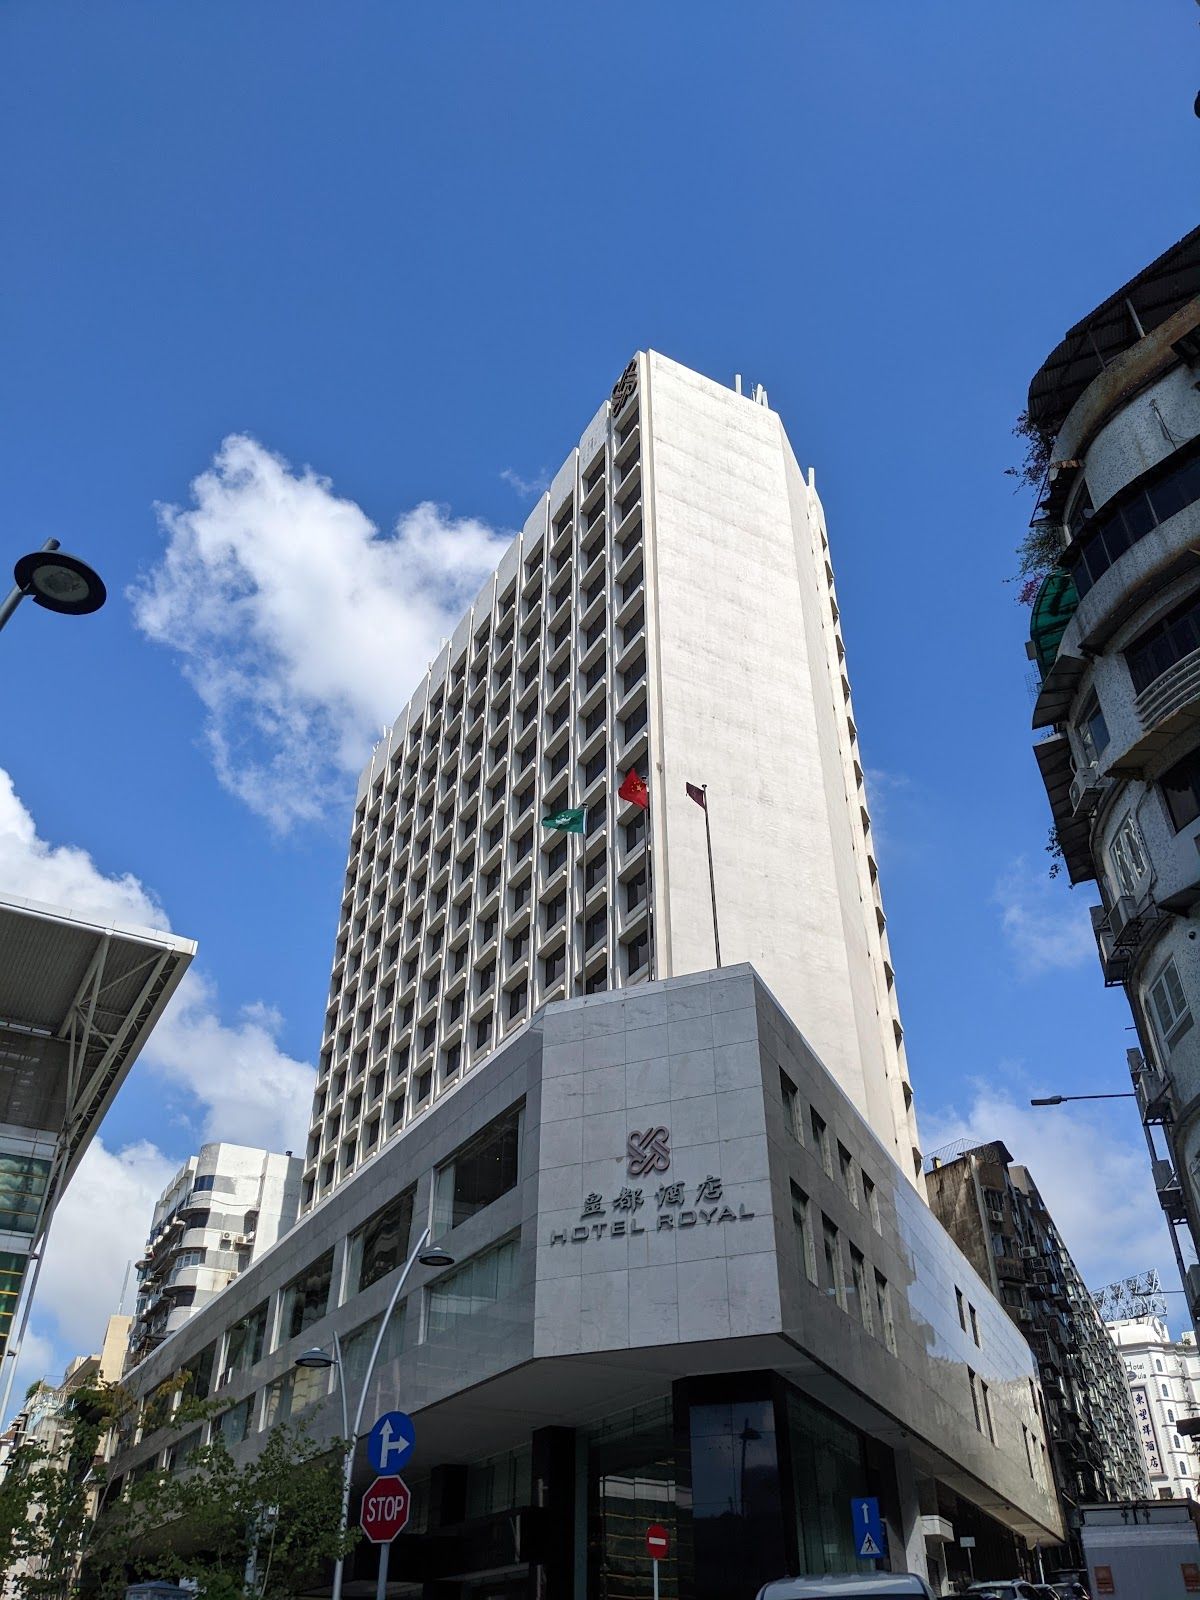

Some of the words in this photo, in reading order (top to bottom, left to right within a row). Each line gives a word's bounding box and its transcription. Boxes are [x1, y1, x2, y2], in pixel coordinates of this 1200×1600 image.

[581, 1175, 722, 1220] 皇都酒店
[551, 1218, 645, 1245] HOTEL
[657, 1203, 755, 1233] ROYAL
[1124, 1361, 1144, 1370] Hotel
[1136, 1393, 1159, 1468] 東望洋酒店
[366, 1495, 404, 1523] STOP
